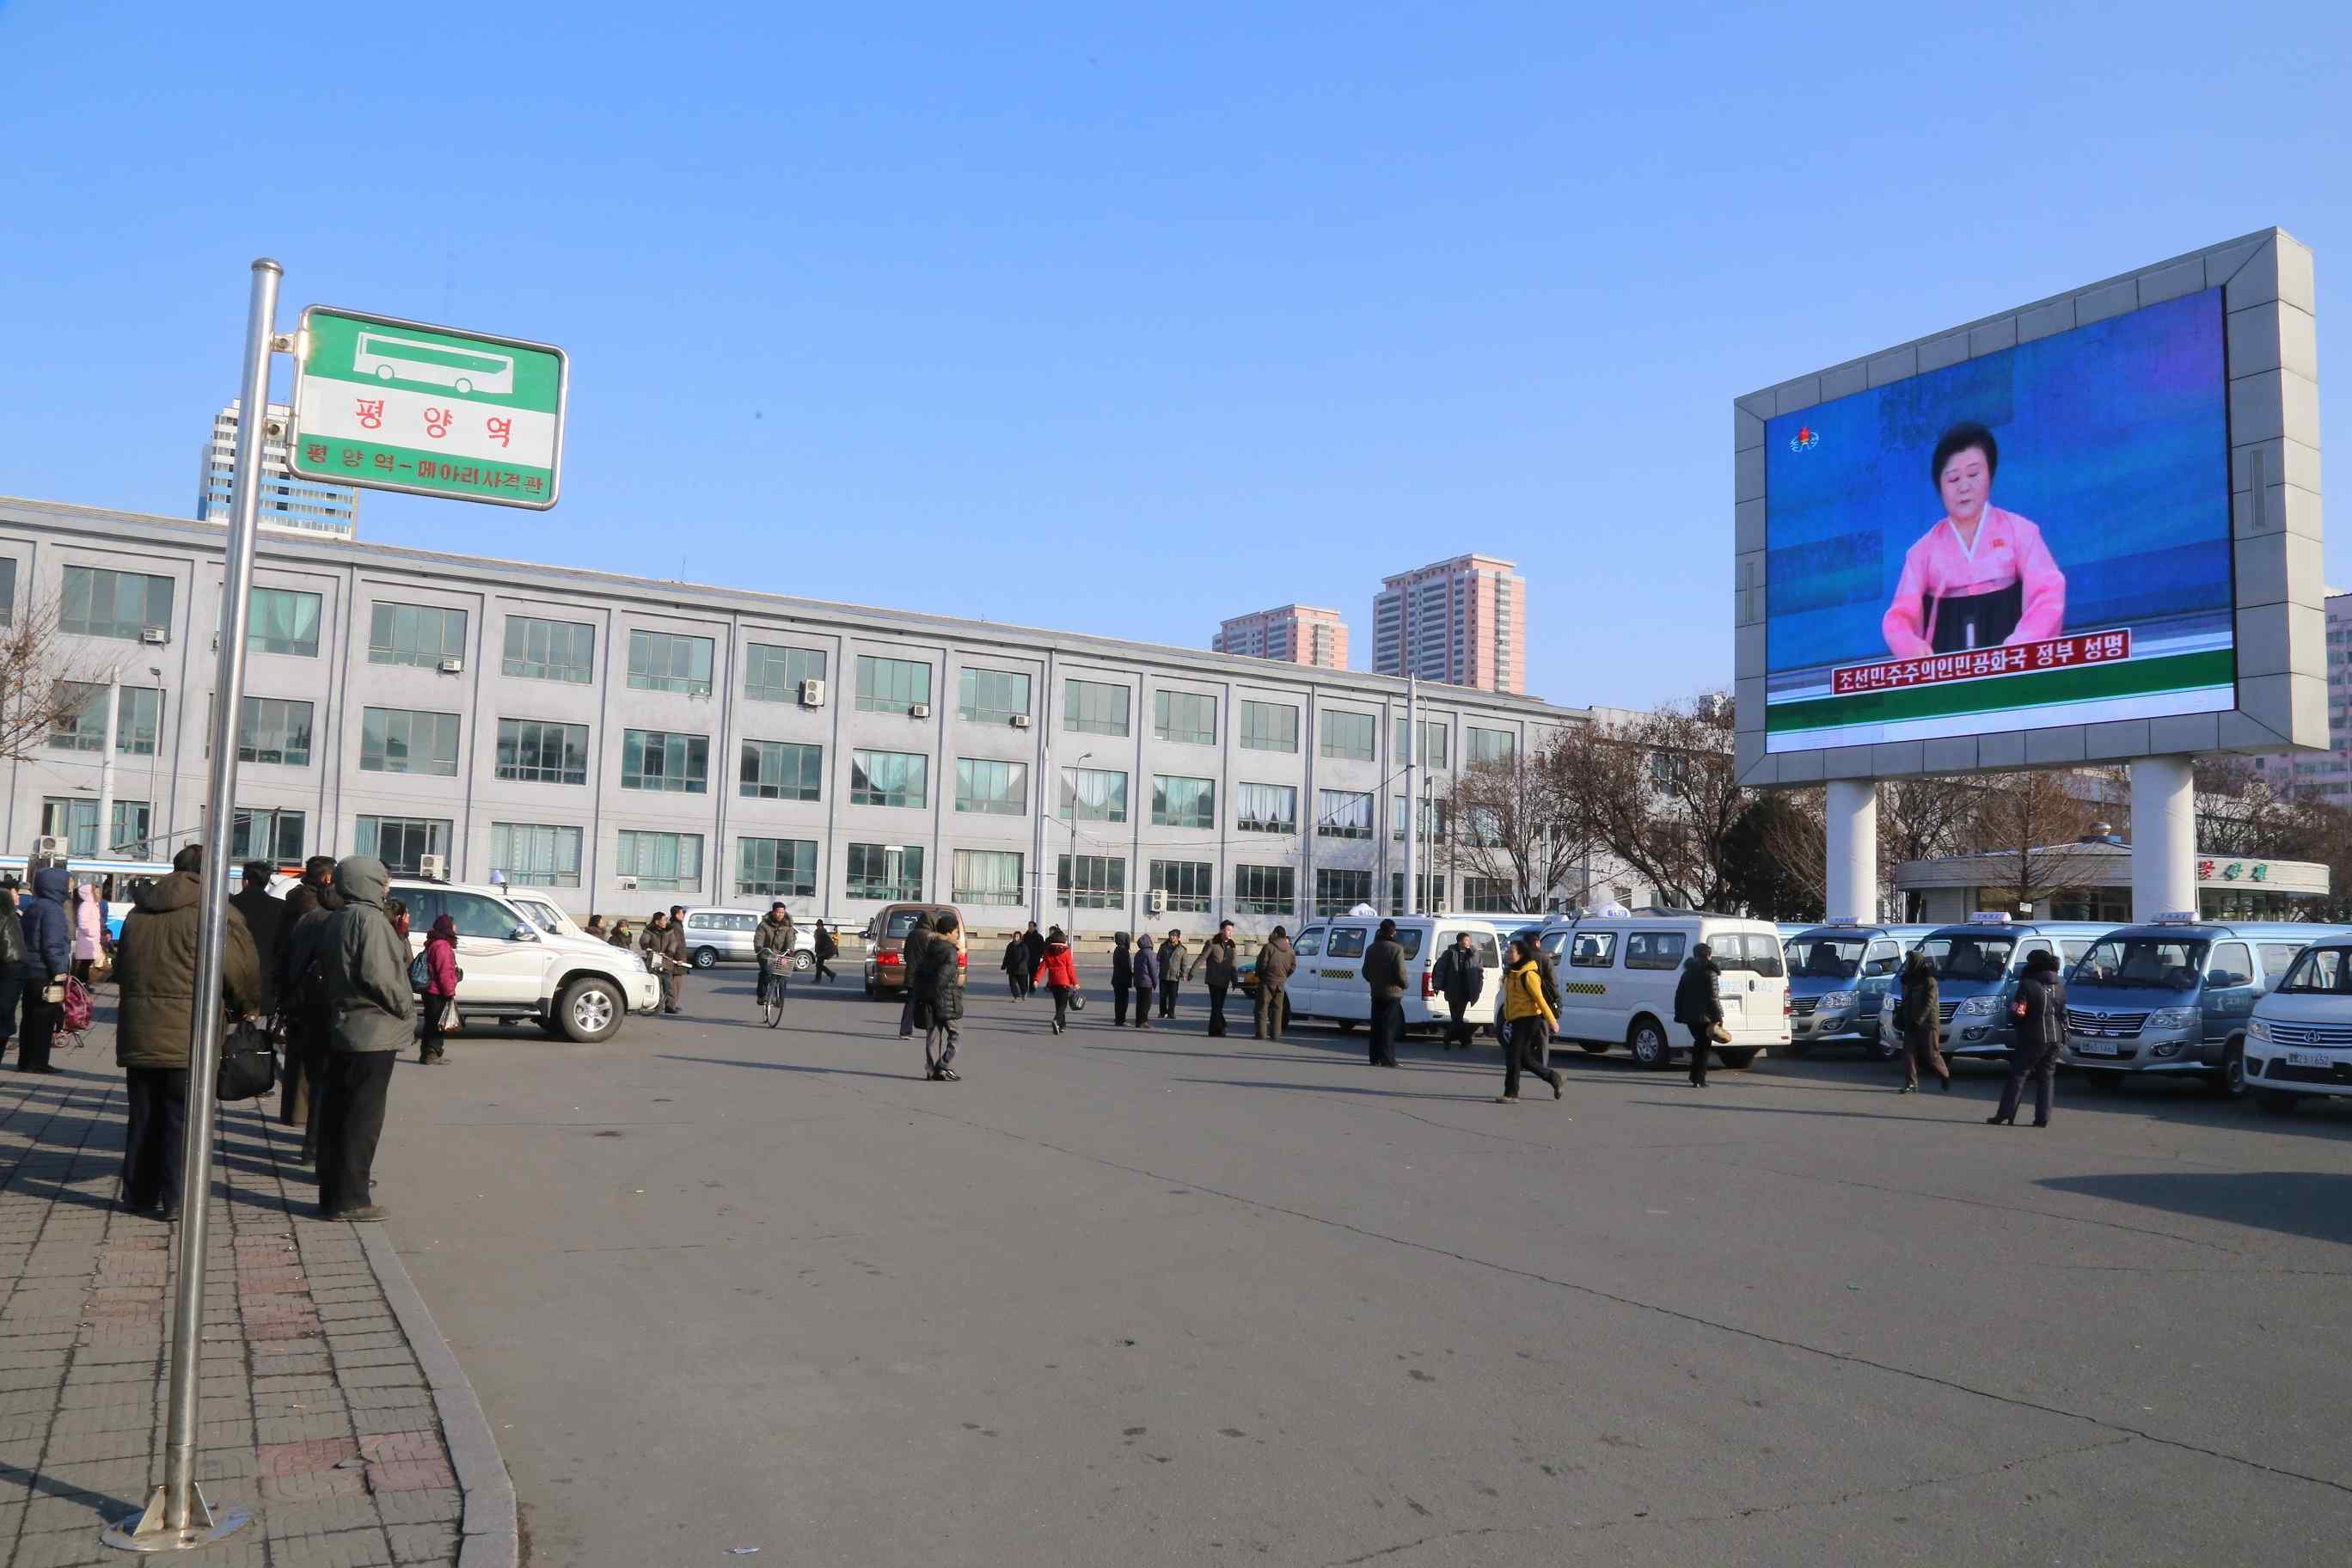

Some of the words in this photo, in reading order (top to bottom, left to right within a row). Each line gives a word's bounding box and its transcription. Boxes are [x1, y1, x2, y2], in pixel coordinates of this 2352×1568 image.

[1838, 646, 2028, 691] 조선민주주의인민공화국
[2036, 640, 2074, 666] 정부
[2084, 634, 2124, 660] 성명
